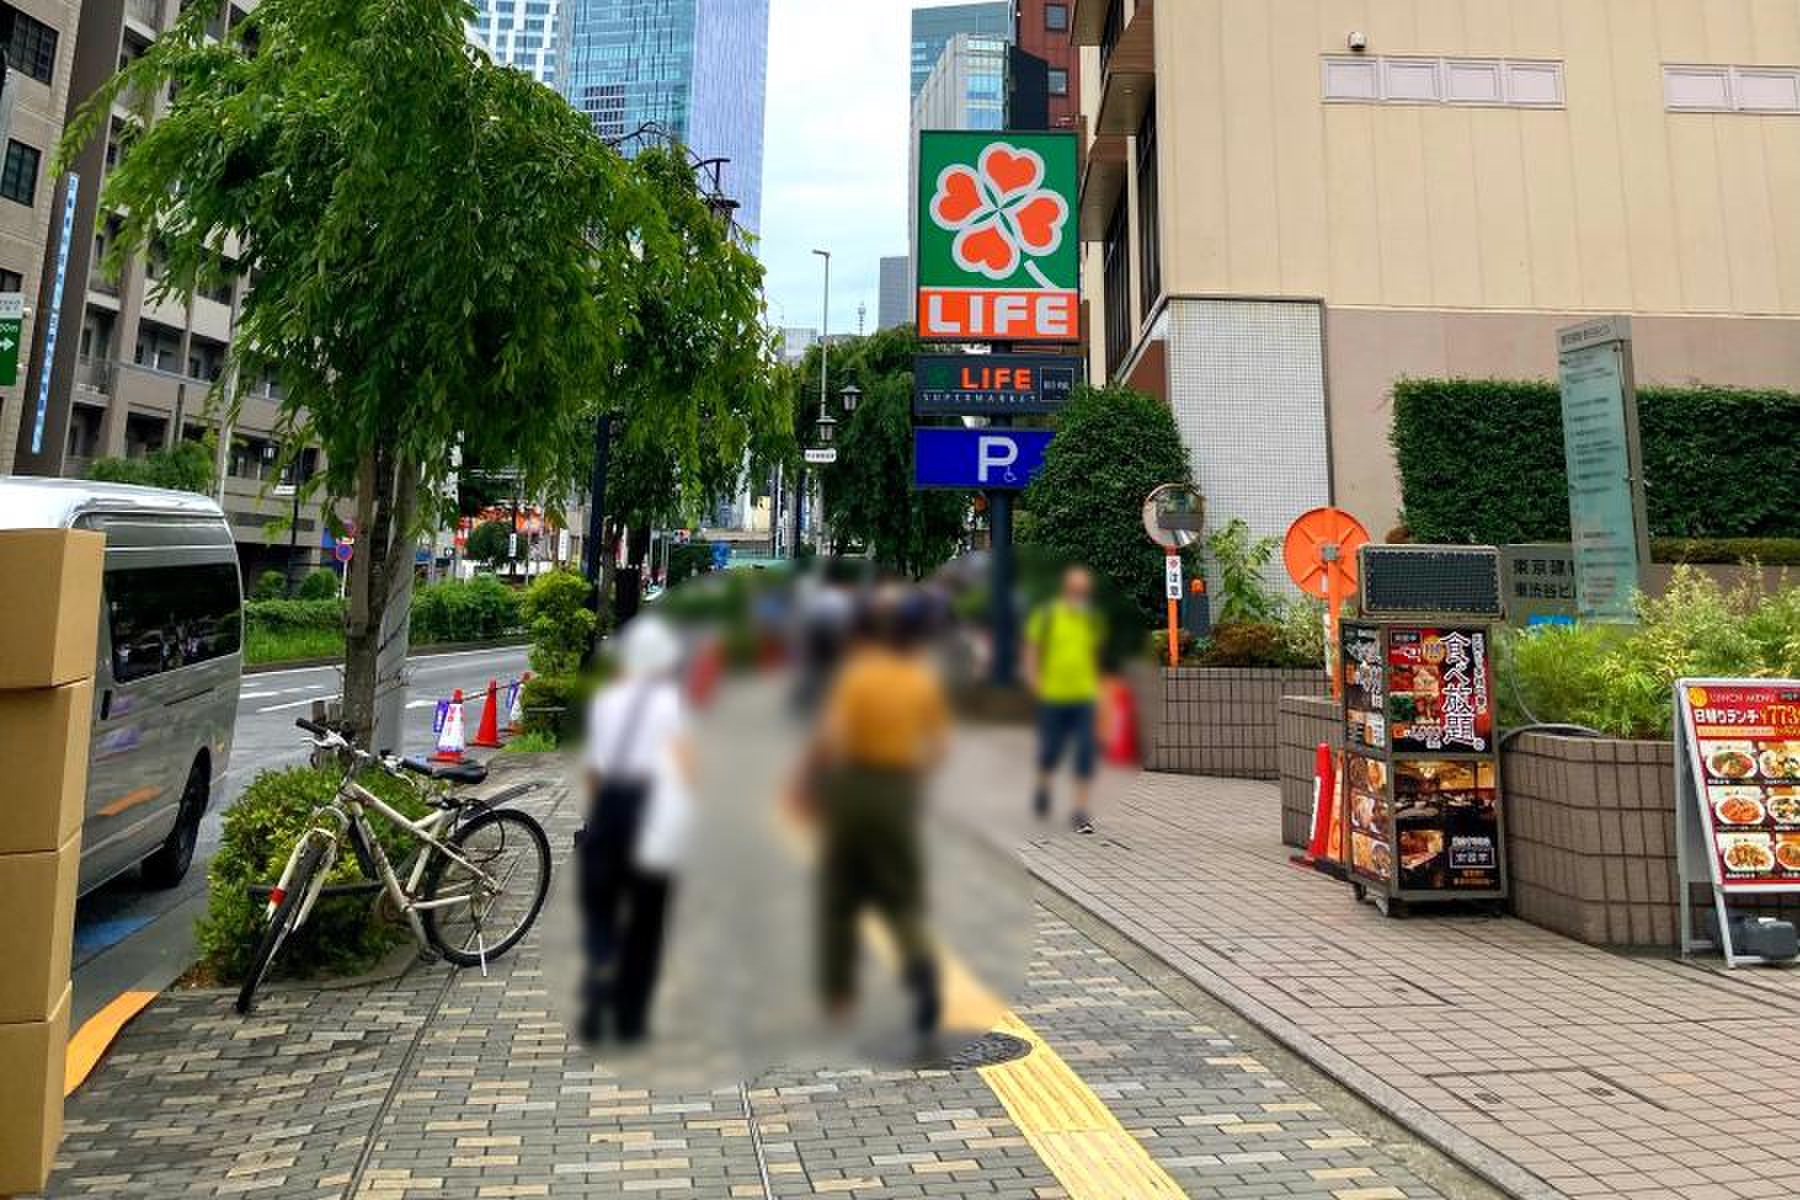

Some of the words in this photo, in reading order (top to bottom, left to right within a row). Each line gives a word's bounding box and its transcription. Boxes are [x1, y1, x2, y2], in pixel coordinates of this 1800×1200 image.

[927, 294, 1068, 335] LIFE
[960, 367, 1032, 391] LIFE
[977, 435, 1019, 482] P
